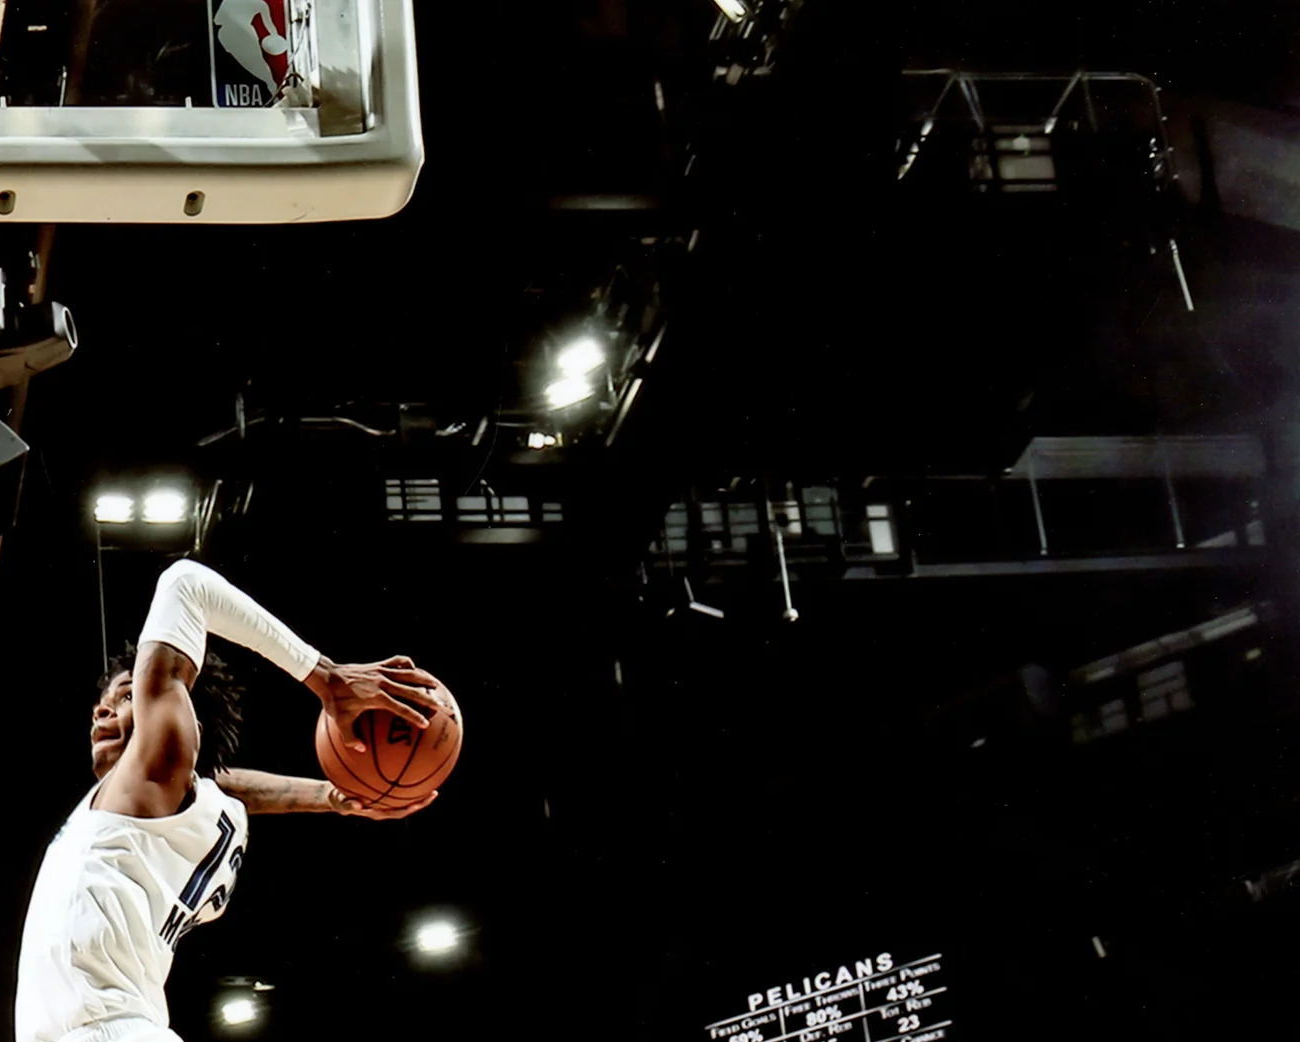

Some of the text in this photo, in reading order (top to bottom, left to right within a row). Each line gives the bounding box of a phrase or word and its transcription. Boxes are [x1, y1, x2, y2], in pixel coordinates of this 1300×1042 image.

[225, 84, 263, 106] NBA
[748, 952, 894, 1012] PELICANS
[886, 980, 925, 1002] 43%
[805, 1004, 843, 1027] 80%
[897, 1014, 921, 1033] 23
